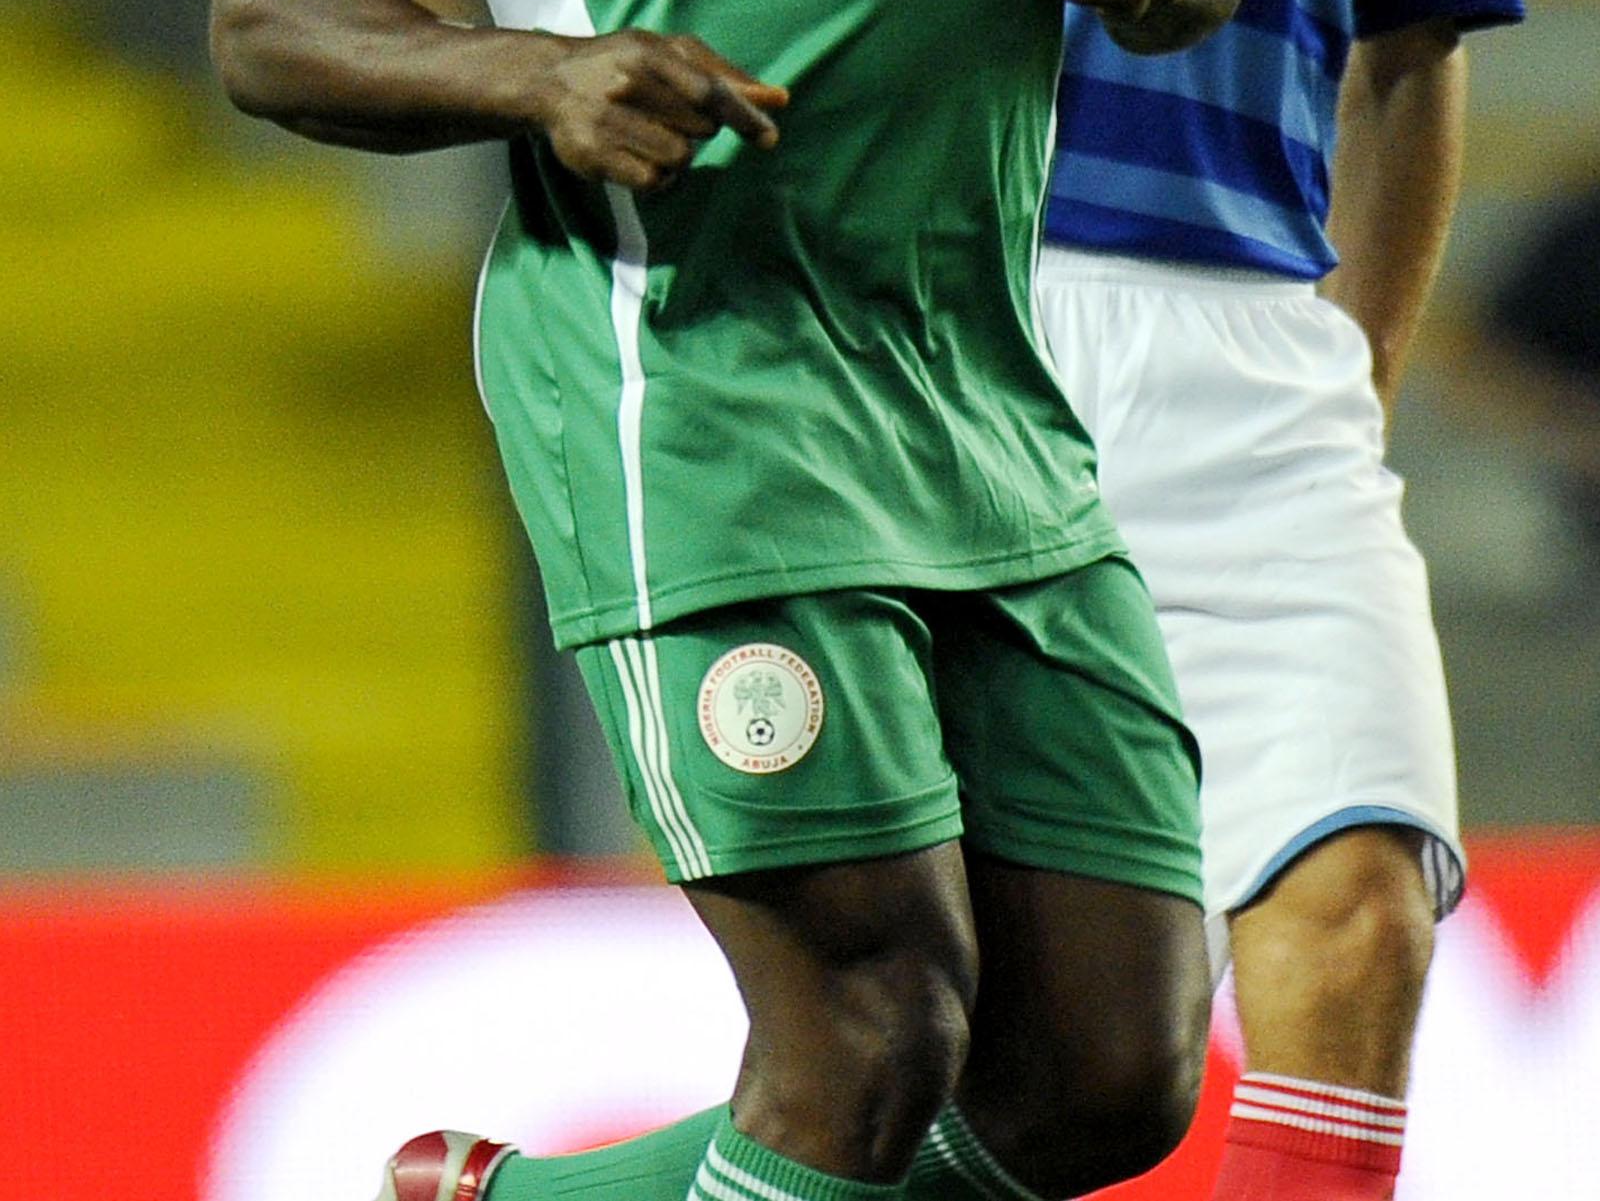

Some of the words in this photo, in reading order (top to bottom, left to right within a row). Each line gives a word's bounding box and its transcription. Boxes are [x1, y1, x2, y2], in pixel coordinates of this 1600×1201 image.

[710, 648, 773, 684] FOOTBALL
[780, 653, 820, 733] FEDERATION
[703, 689, 720, 746] NIGERIA
[742, 756, 788, 769] ABUJA
